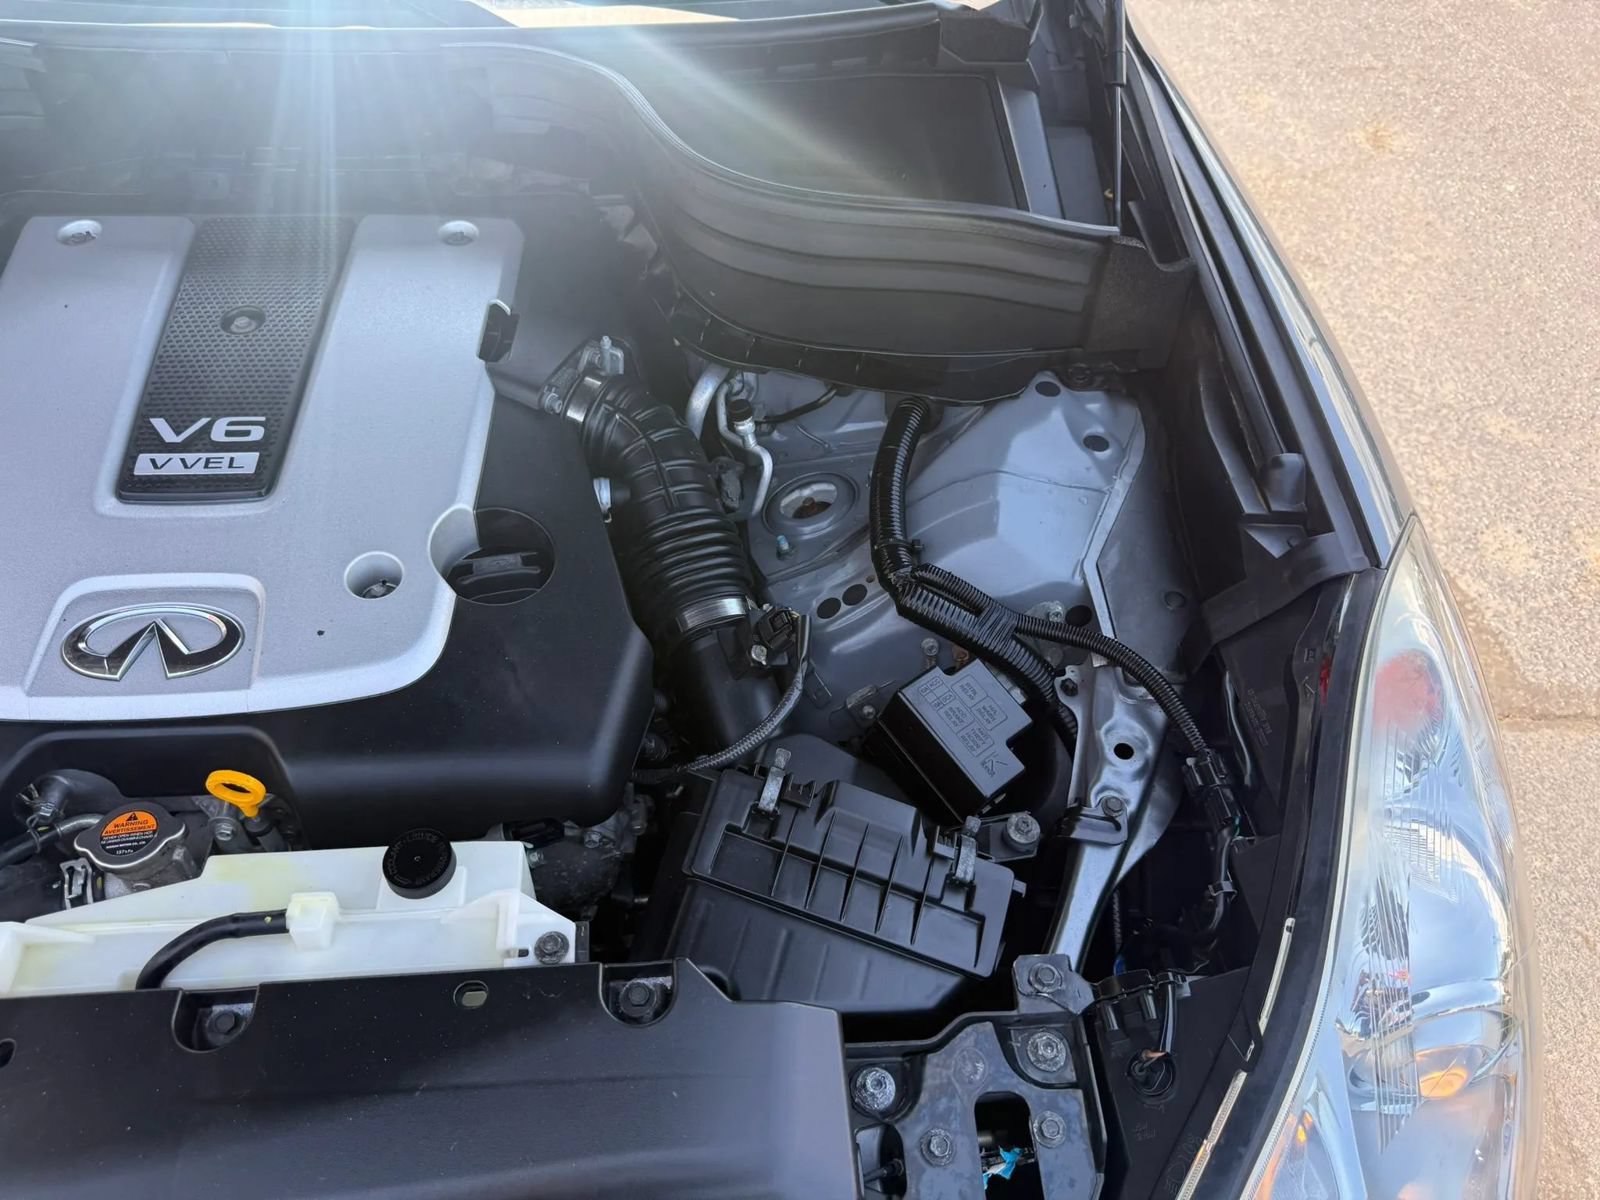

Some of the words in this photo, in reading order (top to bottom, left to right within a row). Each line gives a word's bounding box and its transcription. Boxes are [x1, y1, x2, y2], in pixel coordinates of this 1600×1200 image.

[149, 416, 266, 442] V6
[149, 456, 245, 470] VVEL
[114, 819, 149, 829] WARNING
